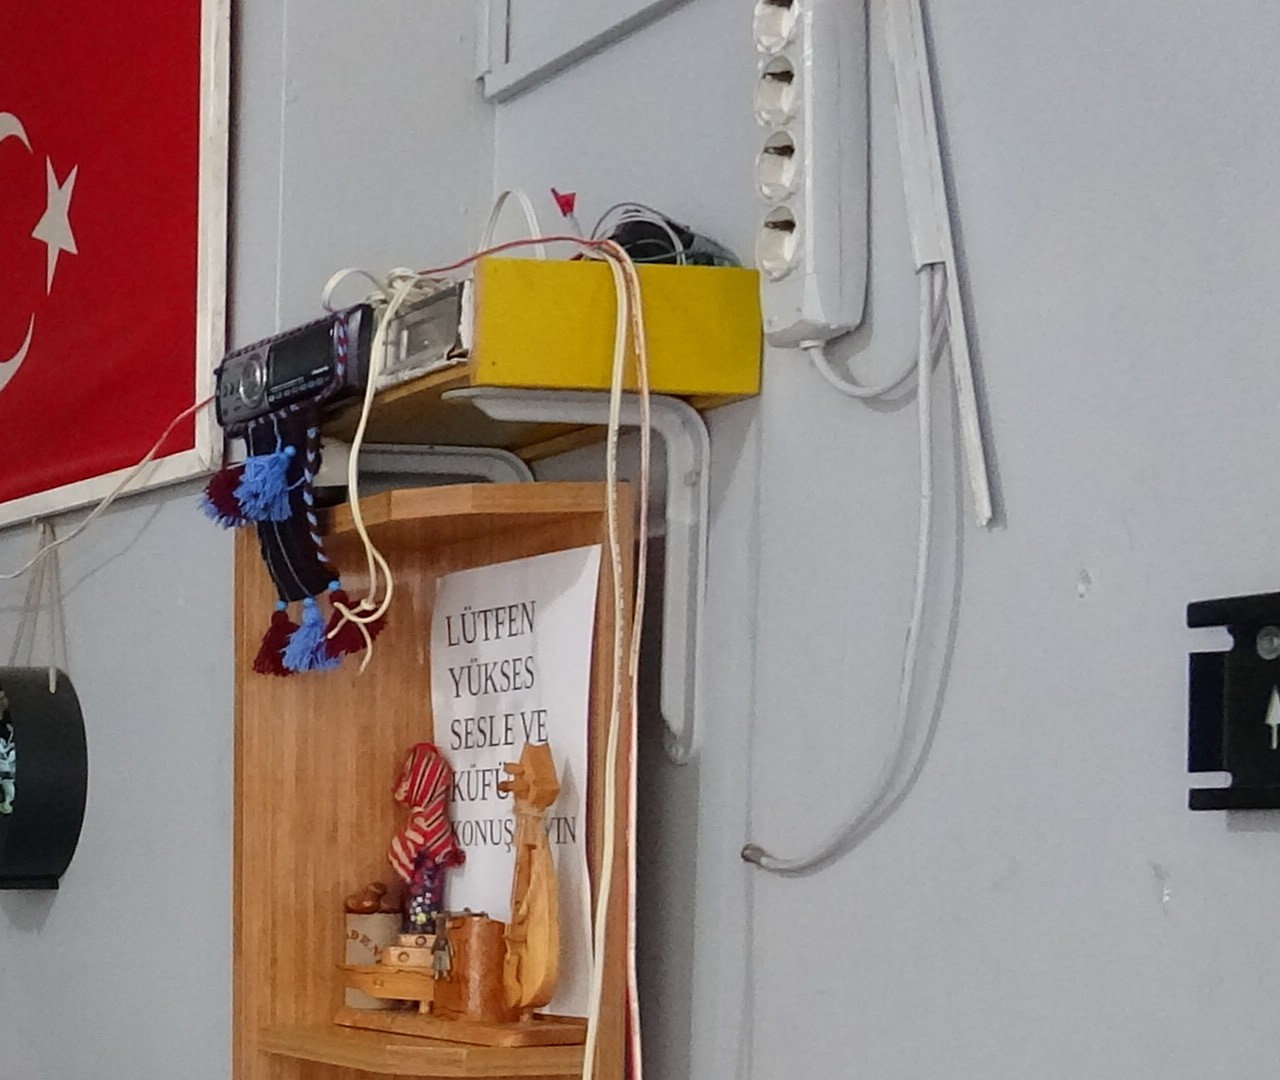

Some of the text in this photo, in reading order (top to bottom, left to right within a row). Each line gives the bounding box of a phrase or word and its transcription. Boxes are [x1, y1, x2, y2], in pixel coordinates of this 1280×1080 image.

[446, 601, 536, 647] LÜTFEN
[448, 656, 535, 698] YÜKSES
[451, 710, 549, 750] SESLE VE
